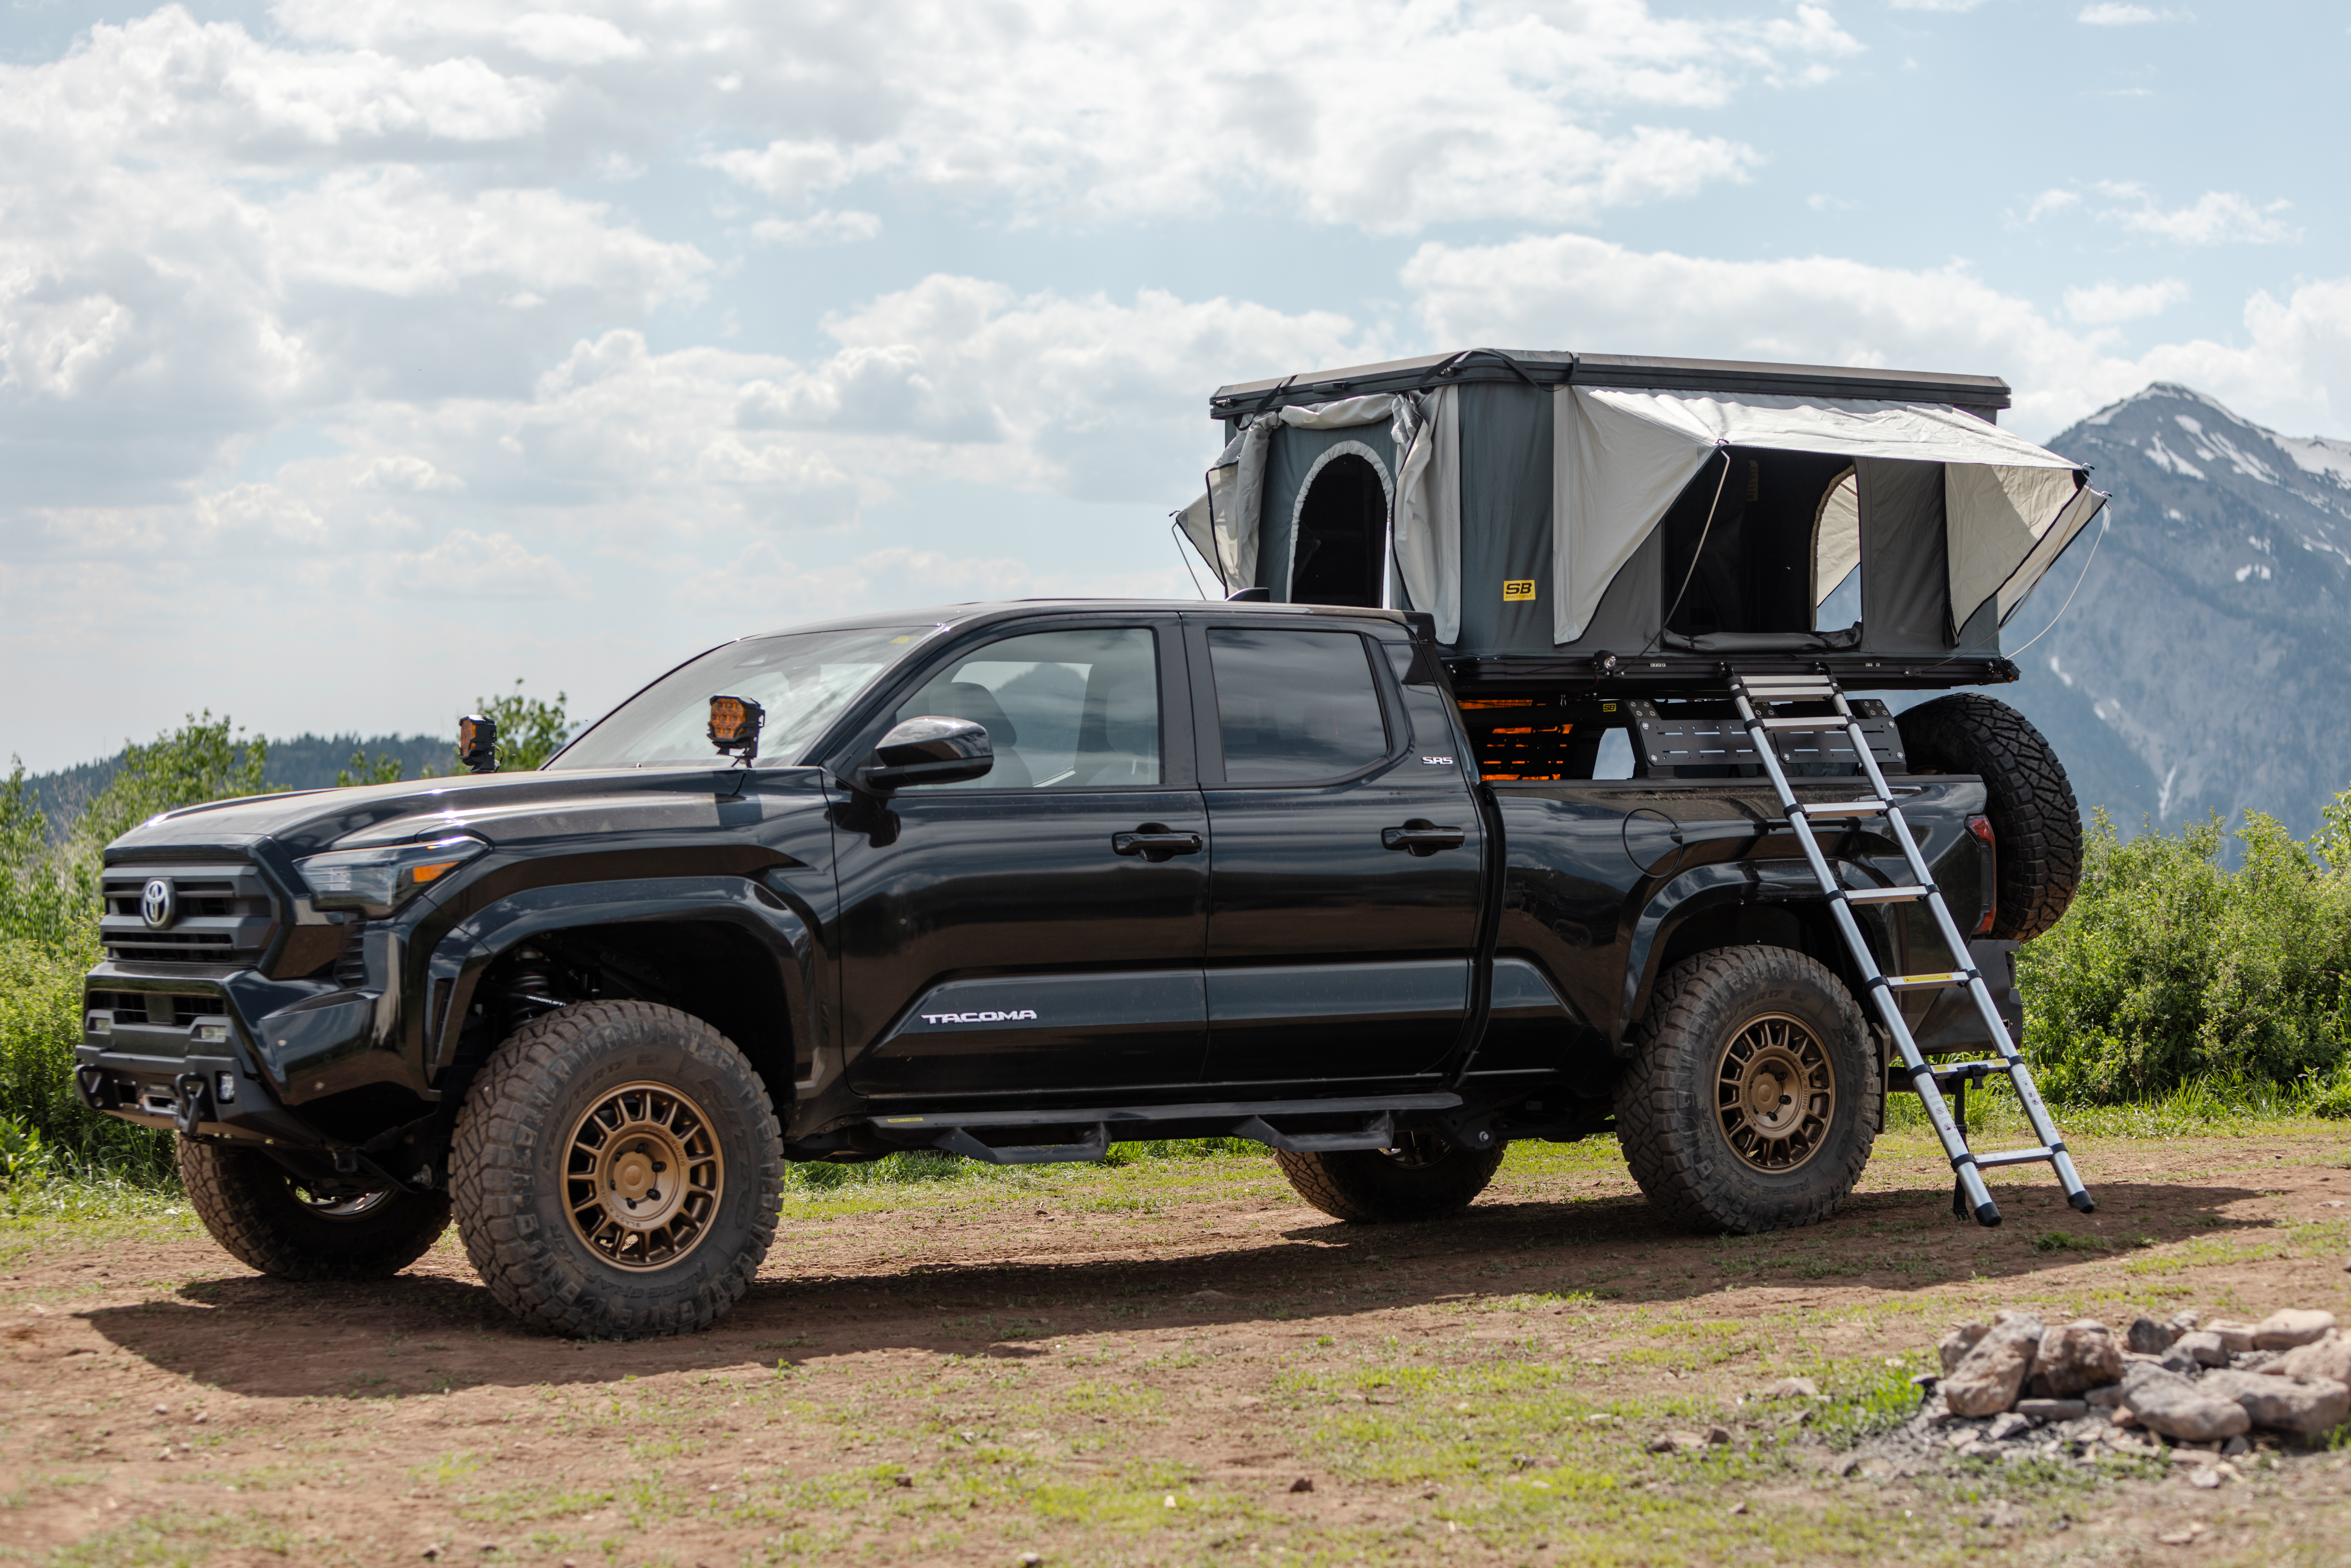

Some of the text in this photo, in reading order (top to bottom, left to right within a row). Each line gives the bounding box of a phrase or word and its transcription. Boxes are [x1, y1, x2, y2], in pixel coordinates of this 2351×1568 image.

[1506, 583, 1532, 594] SB
[1422, 756, 1453, 764] SR5
[921, 1010, 1037, 1024] TACOMA
